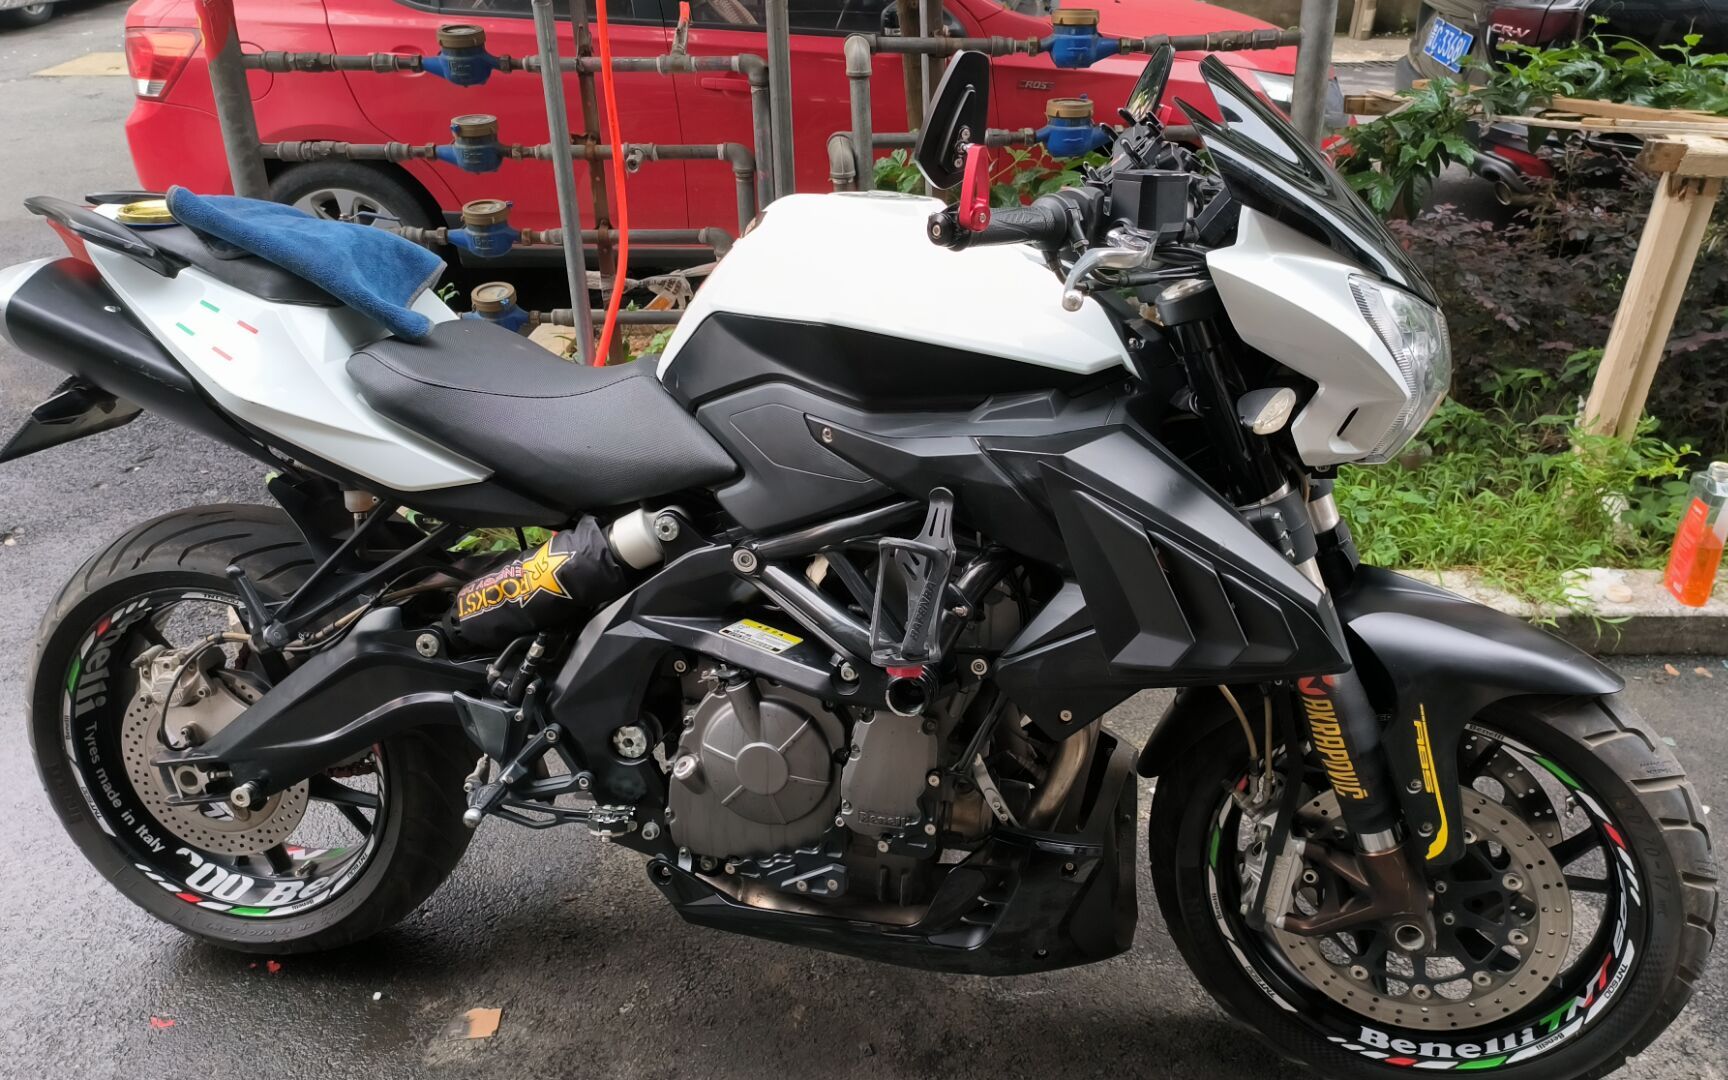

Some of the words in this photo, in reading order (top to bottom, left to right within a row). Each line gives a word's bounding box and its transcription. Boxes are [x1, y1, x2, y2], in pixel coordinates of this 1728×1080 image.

[1491, 23, 1531, 38] CR-V
[1469, 724, 1505, 741] Benelli
[1413, 720, 1435, 793] ABS
[84, 721, 101, 765] Tyres
[96, 767, 122, 808] made
[121, 808, 136, 826] in
[135, 824, 166, 853] Italy
[1212, 892, 1223, 920] Benelli
[1603, 964, 1629, 999] TNT600
[1357, 1026, 1535, 1059] Benelli
[1539, 952, 1613, 1033] TNT
[1536, 1032, 1565, 1051] Benelli
